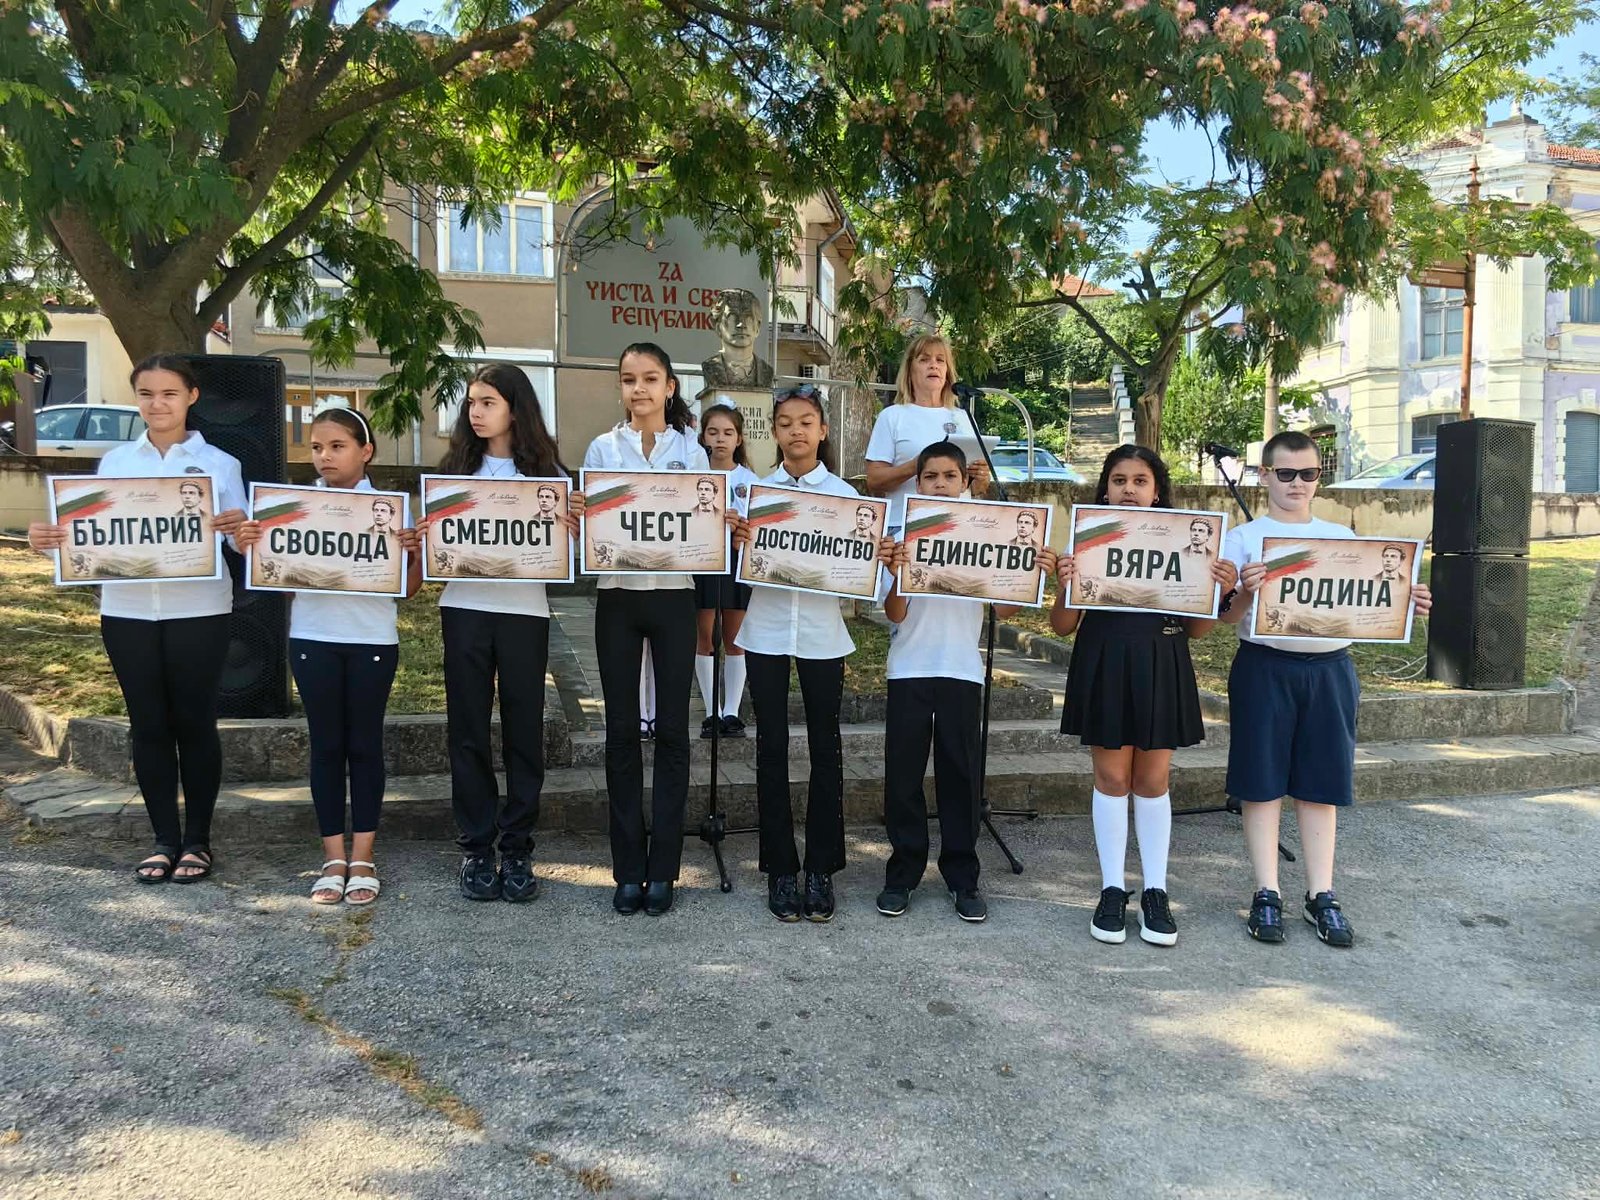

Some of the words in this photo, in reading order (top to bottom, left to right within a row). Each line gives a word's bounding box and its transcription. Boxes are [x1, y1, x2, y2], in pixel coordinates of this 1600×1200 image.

[663, 286, 677, 304] И
[612, 306, 714, 333] РЕПУБЛИК
[72, 516, 203, 546] БЪЛГАРИЯ
[441, 518, 554, 546] СМЕЛОСТ
[620, 511, 692, 542] ЧЕСТ
[270, 527, 389, 562] СВОБОДА
[754, 527, 874, 562] ДОСТОЙНСТВО
[915, 538, 1037, 571] ЕДИНСТВО
[1105, 547, 1182, 582] ВЯРА
[1279, 577, 1392, 609] РОДИНА
